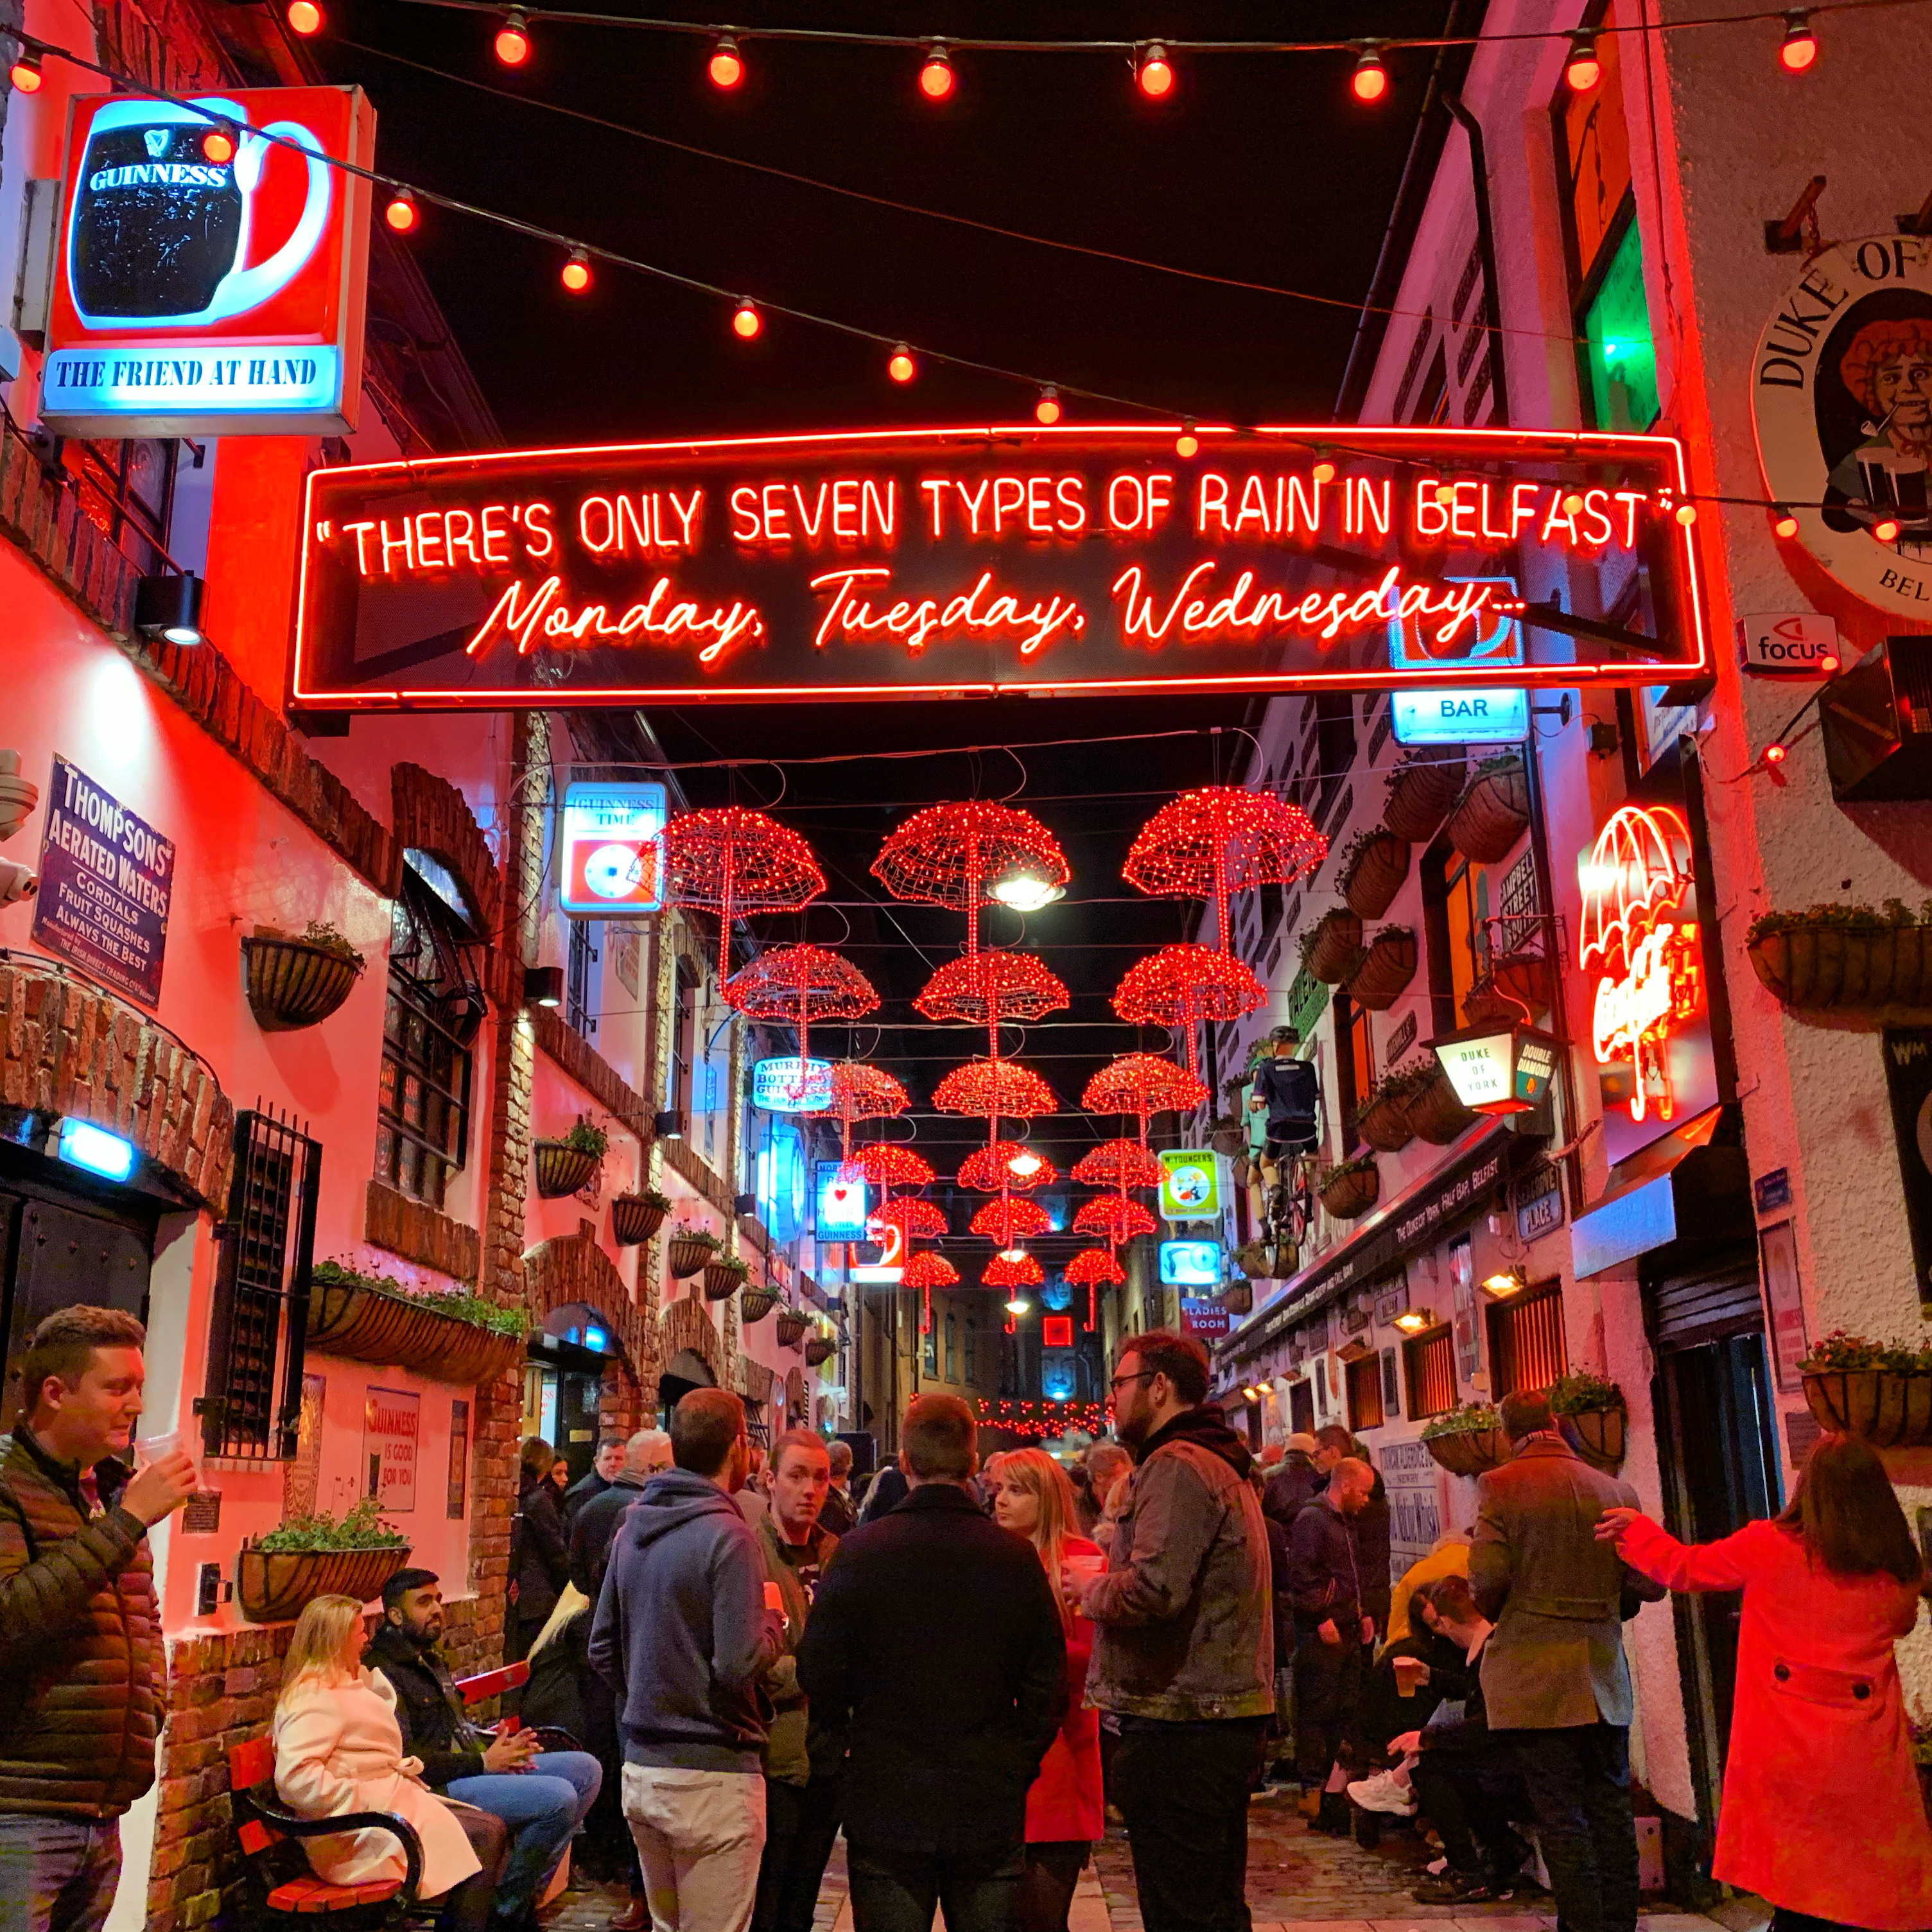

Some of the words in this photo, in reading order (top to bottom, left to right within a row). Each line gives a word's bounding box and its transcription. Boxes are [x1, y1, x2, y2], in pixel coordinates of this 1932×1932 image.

[90, 164, 229, 192] GUINNESS
[1760, 268, 1849, 390] DUKE
[1856, 239, 1921, 281] OF
[57, 361, 106, 388] THE
[112, 360, 203, 387] FRIEND
[209, 360, 241, 385] AT
[248, 359, 317, 385] HAND
[580, 490, 702, 552] ONLY
[731, 480, 895, 541] SEVEN
[921, 477, 1086, 537] TYPES
[1109, 475, 1174, 530] OF
[1199, 474, 1320, 533] RAIN
[1346, 477, 1391, 534] IN
[1879, 568, 1929, 602] BEL
[466, 575, 763, 662] Monday,
[810, 569, 1085, 654] Tuesday,
[1758, 636, 1829, 661] focus
[1441, 699, 1489, 717] BAR
[577, 799, 655, 811] GUINNESS
[596, 814, 635, 826] TIME
[48, 808, 116, 882] AERATED
[118, 855, 168, 918] WATERS
[76, 871, 139, 925] CORDIALS
[1503, 874, 1534, 925] STREET
[41, 916, 74, 940] Manufactured
[74, 936, 82, 946] by
[58, 882, 92, 915] FRUIT
[94, 905, 151, 954] SQUASHES
[56, 904, 100, 943] ALWAYS
[101, 934, 119, 956] THE
[121, 945, 147, 972] BEST
[60, 938, 70, 952] THE
[71, 945, 86, 960] IRISH
[86, 954, 105, 970] DIRECT
[106, 965, 128, 986] TRADING
[1460, 1048, 1490, 1062] DUKE
[1522, 1043, 1551, 1063] DOUBLE
[757, 1074, 831, 1084] BOTTD
[1472, 1065, 1486, 1075] OF
[1517, 1058, 1551, 1079] DIAMOND
[1468, 1079, 1498, 1092] YORK
[758, 1095, 770, 1103] THE
[1472, 1157, 1499, 1190] BELFAST
[1525, 1198, 1551, 1234] PLACE
[817, 1230, 862, 1240] GUINNESS
[1189, 1306, 1227, 1316] LADIES
[1192, 1320, 1224, 1328] ROOM
[368, 1400, 415, 1438] GUINNESS
[385, 1444, 391, 1459] IS
[393, 1445, 413, 1461] GOOD
[383, 1468, 397, 1484] FOR
[399, 1468, 412, 1485] YOU
